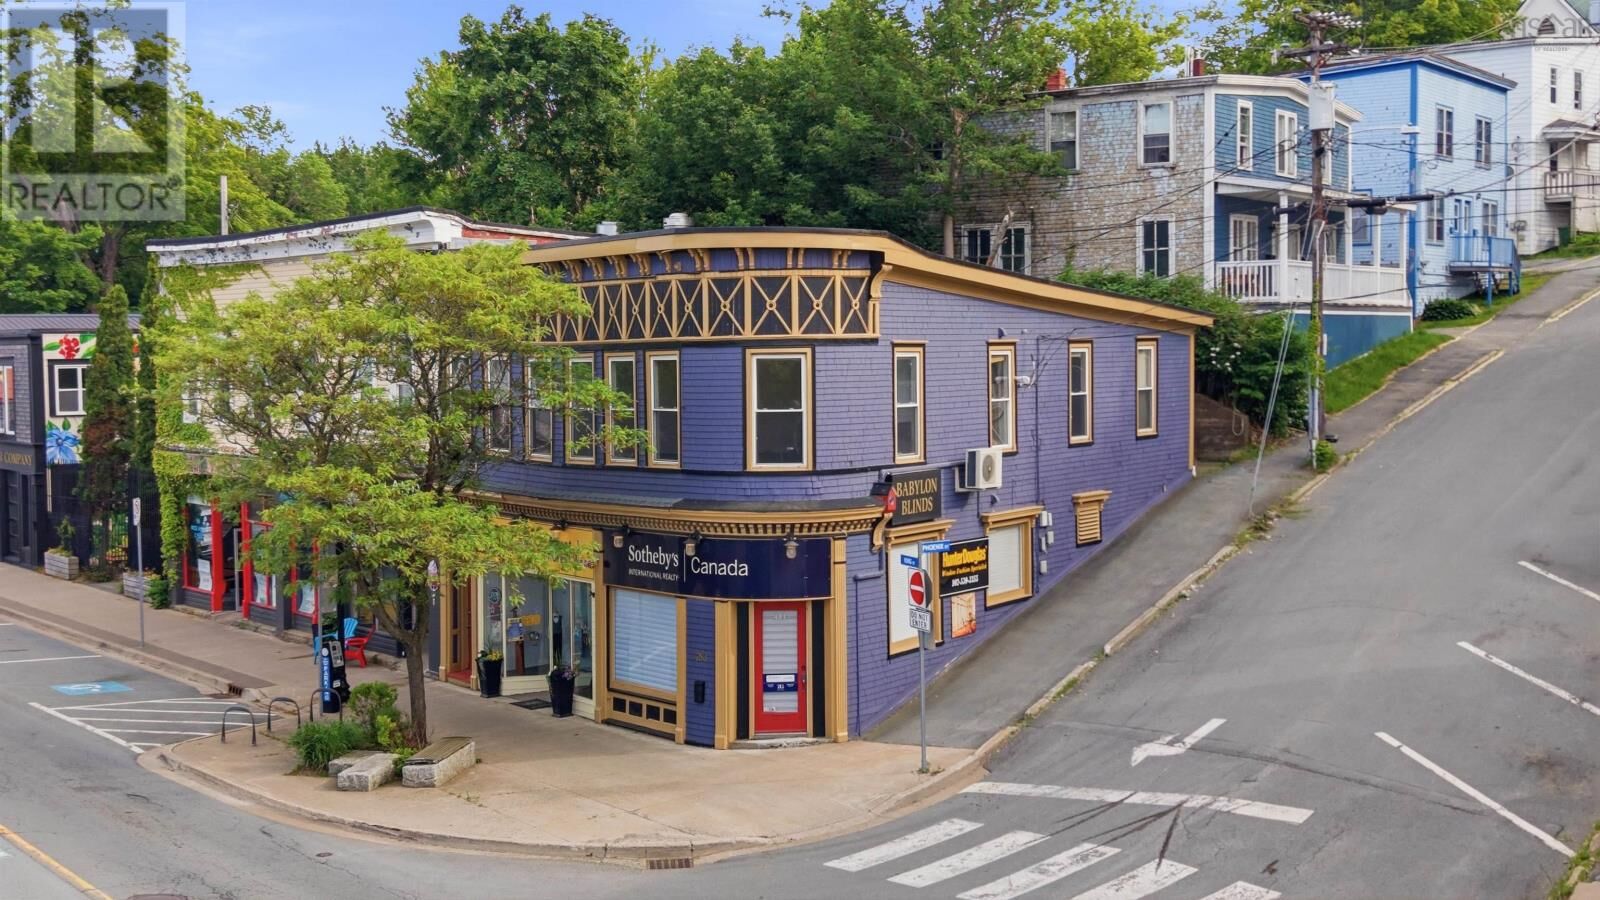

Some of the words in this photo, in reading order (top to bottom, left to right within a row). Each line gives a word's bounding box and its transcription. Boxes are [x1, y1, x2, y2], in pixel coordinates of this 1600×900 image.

[895, 477, 938, 498] BABYLON
[901, 496, 934, 516] BLINDS
[628, 544, 679, 570] Sotheby's
[690, 556, 749, 577] Canada
[628, 568, 662, 579] INTERNATIONAL
[662, 572, 680, 582] REALTY
[911, 618, 927, 628] ENTER
[918, 613, 928, 622] NOT
